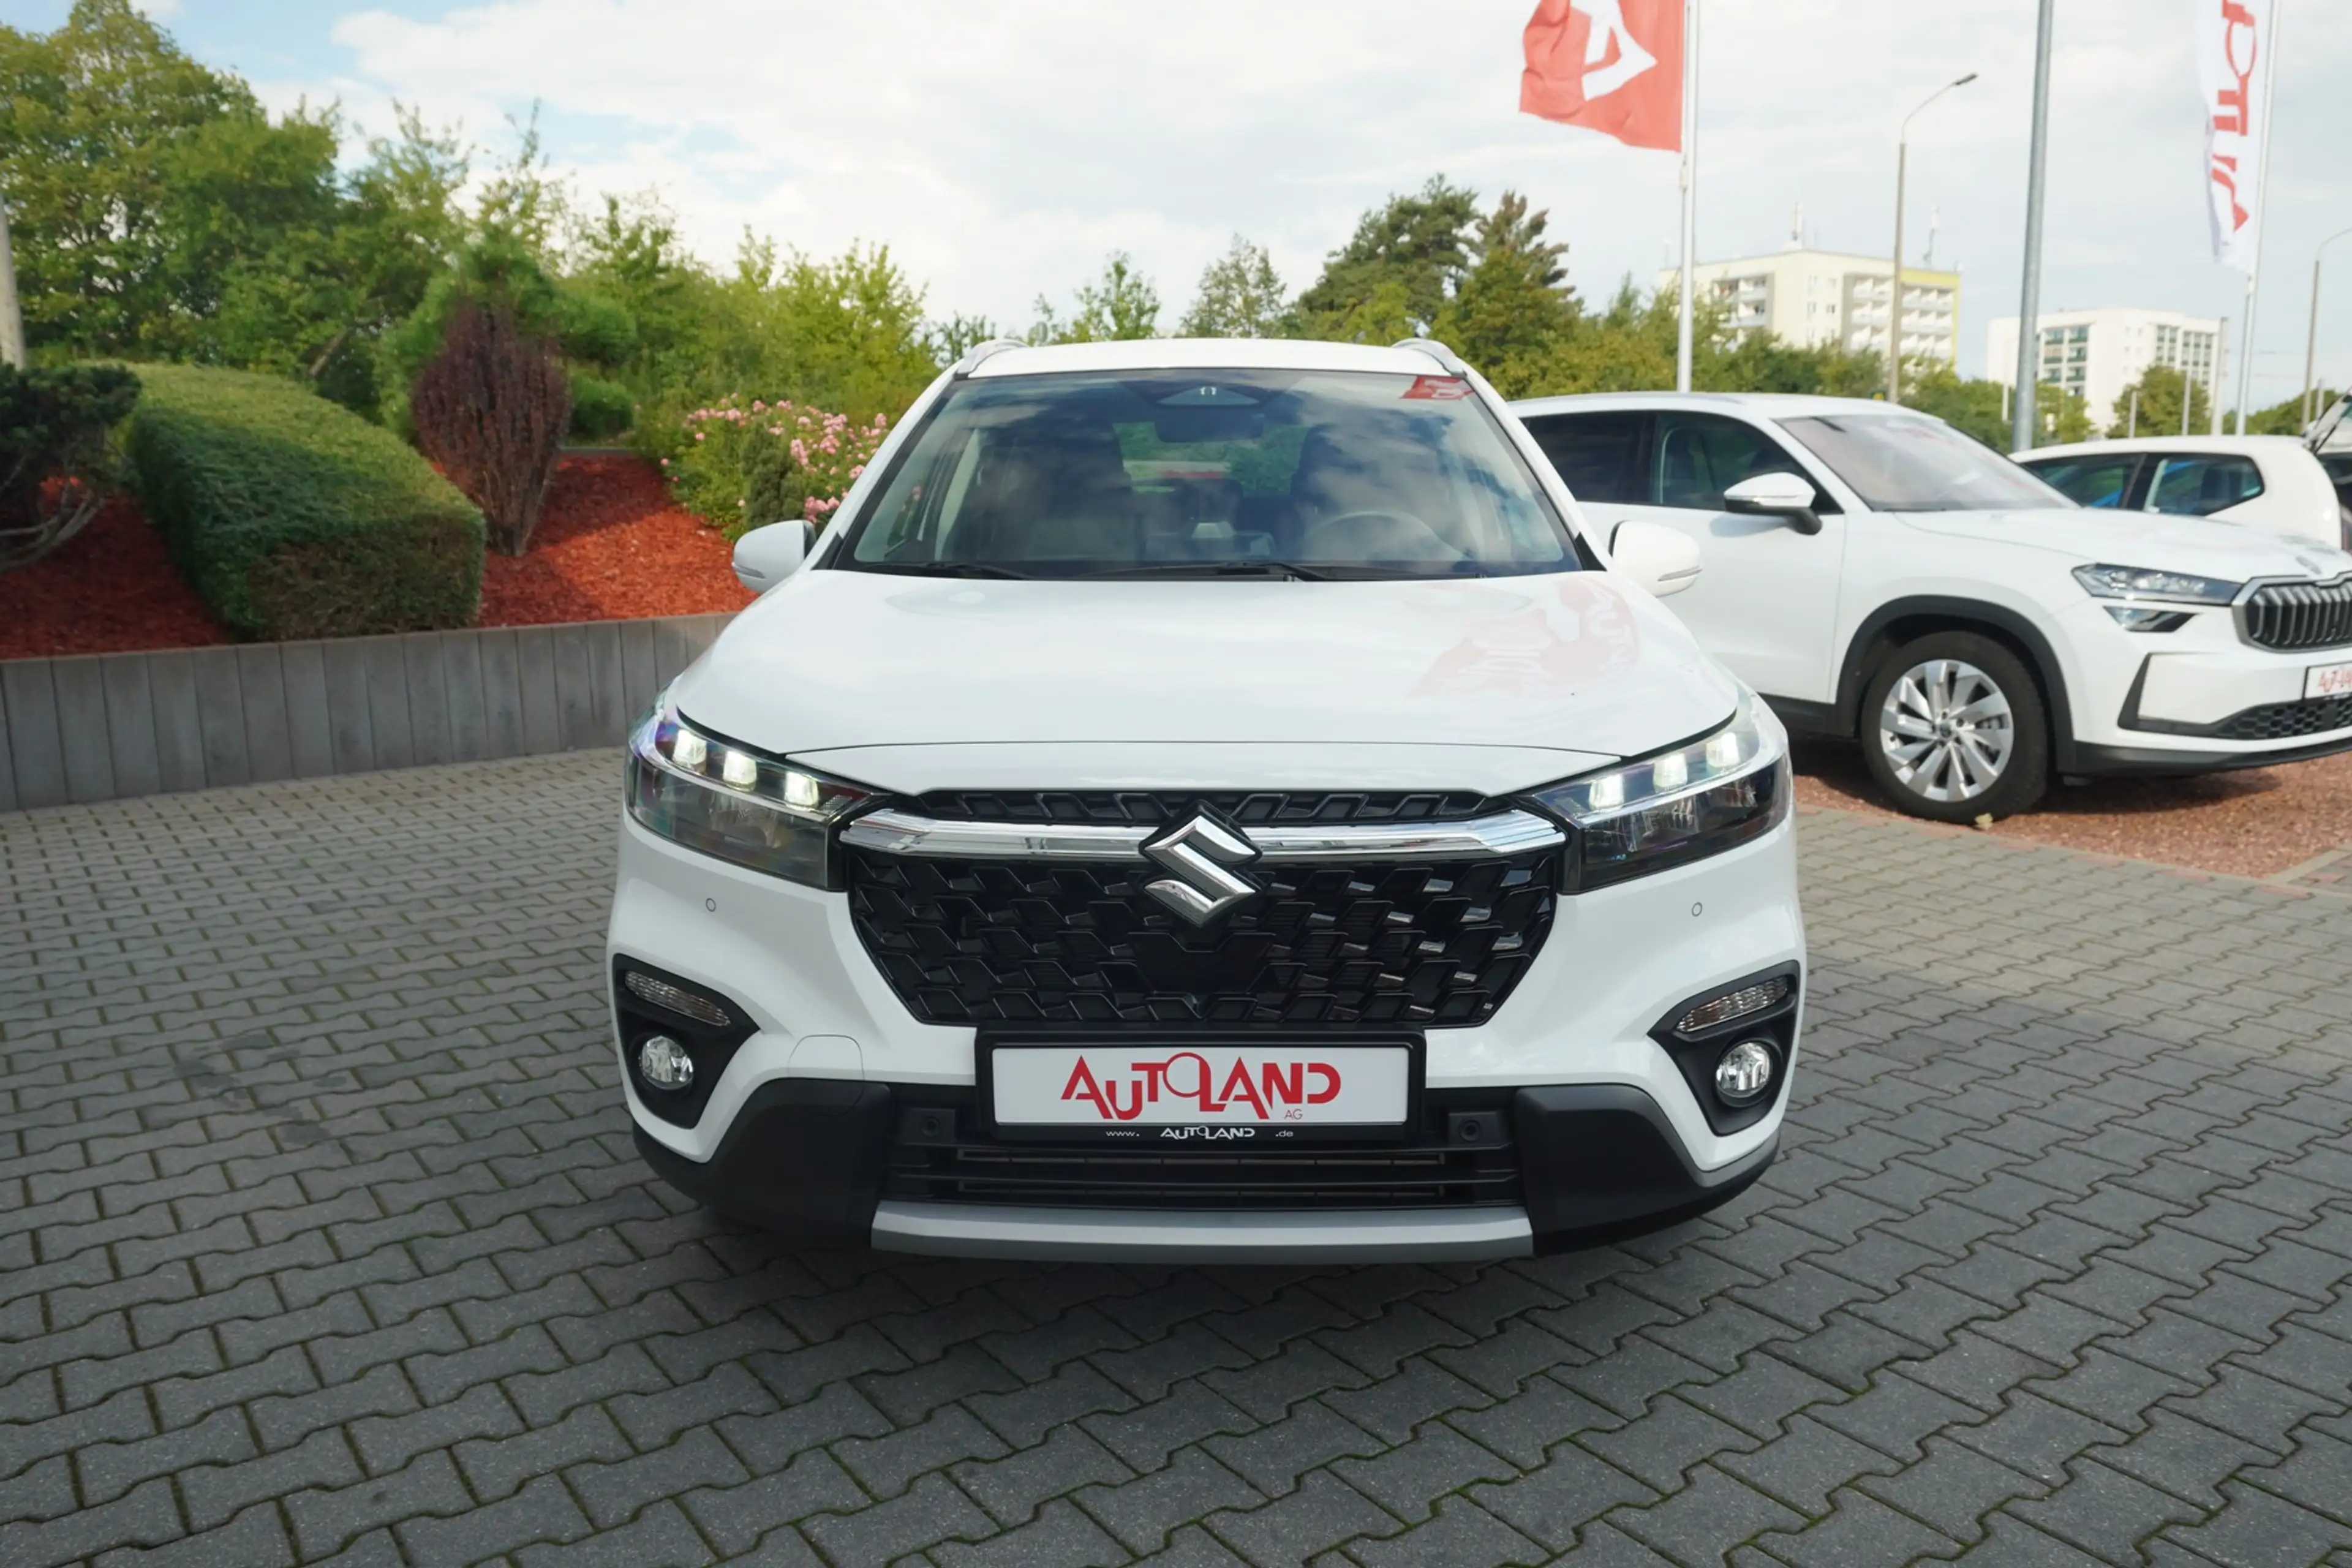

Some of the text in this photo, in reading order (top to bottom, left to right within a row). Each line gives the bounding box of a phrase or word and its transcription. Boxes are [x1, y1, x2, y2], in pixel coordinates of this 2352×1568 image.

[1061, 1052, 1341, 1121] AUTOLAND
[1283, 1108, 1304, 1121] AG
[1160, 1125, 1256, 1140] AUTOLAND
